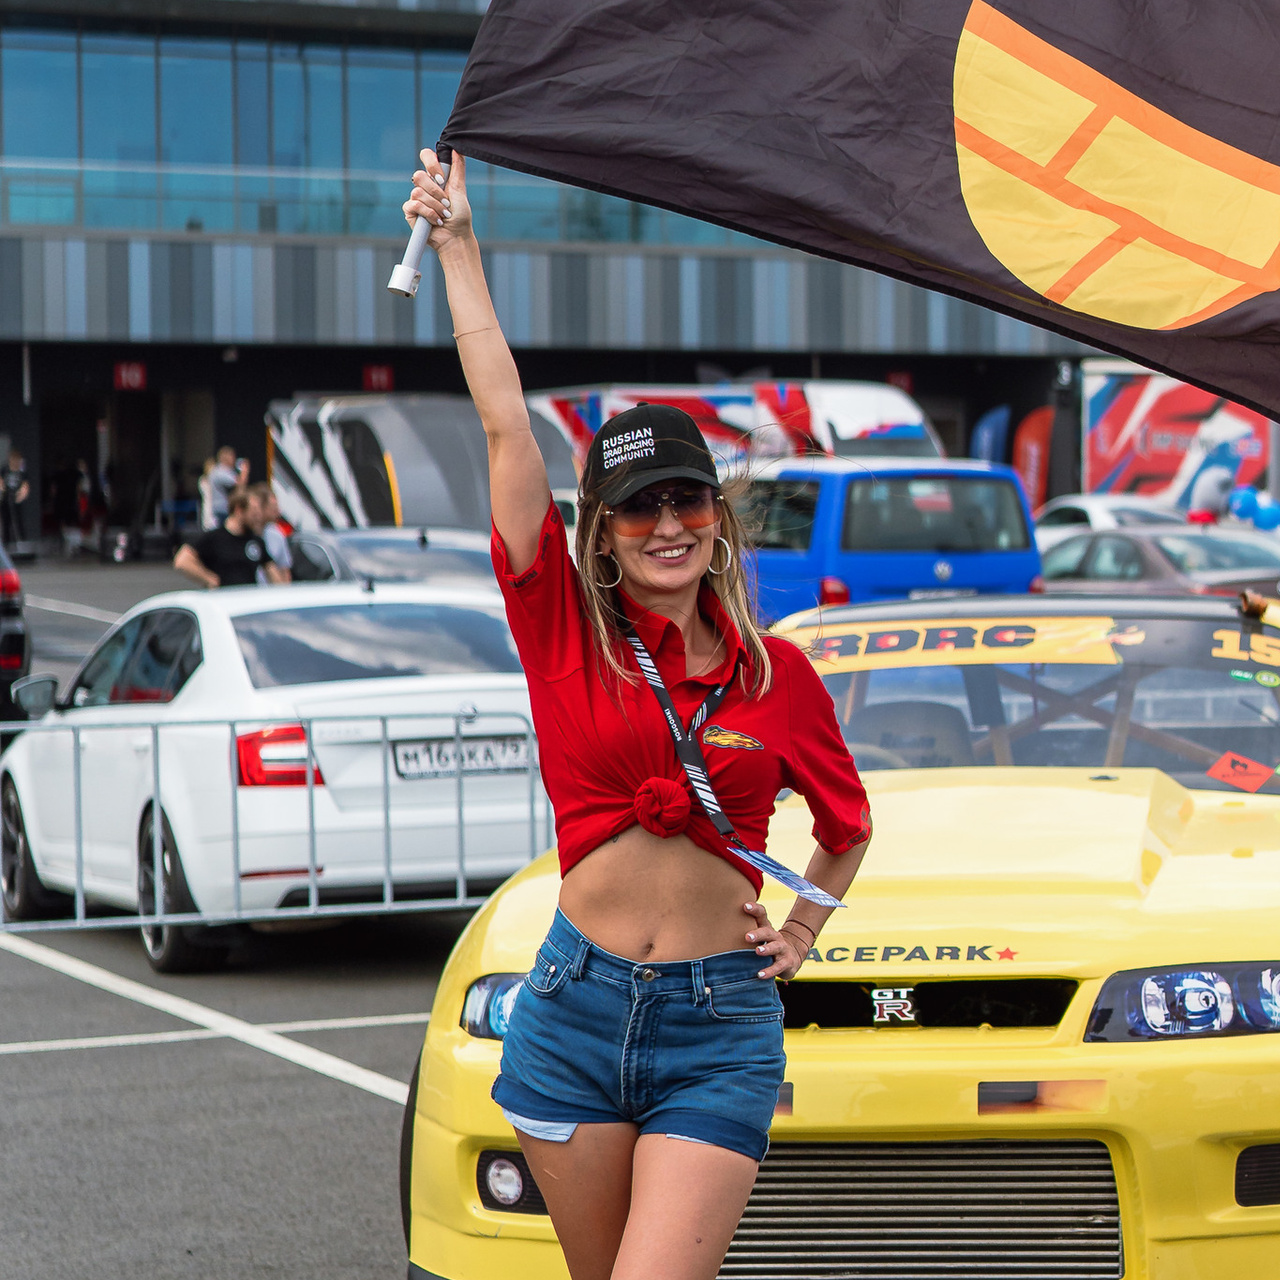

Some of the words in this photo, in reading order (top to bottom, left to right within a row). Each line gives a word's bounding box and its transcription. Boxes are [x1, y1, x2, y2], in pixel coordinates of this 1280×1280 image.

[602, 427, 653, 450] RUSSIAN
[603, 446, 622, 460] DRAG
[623, 438, 655, 452] RACING
[604, 447, 655, 469] COMMUNITY
[811, 625, 1036, 659] RDRC
[806, 946, 993, 962] ACEPARK
[871, 988, 914, 1000] GT
[874, 1000, 915, 1021] R
